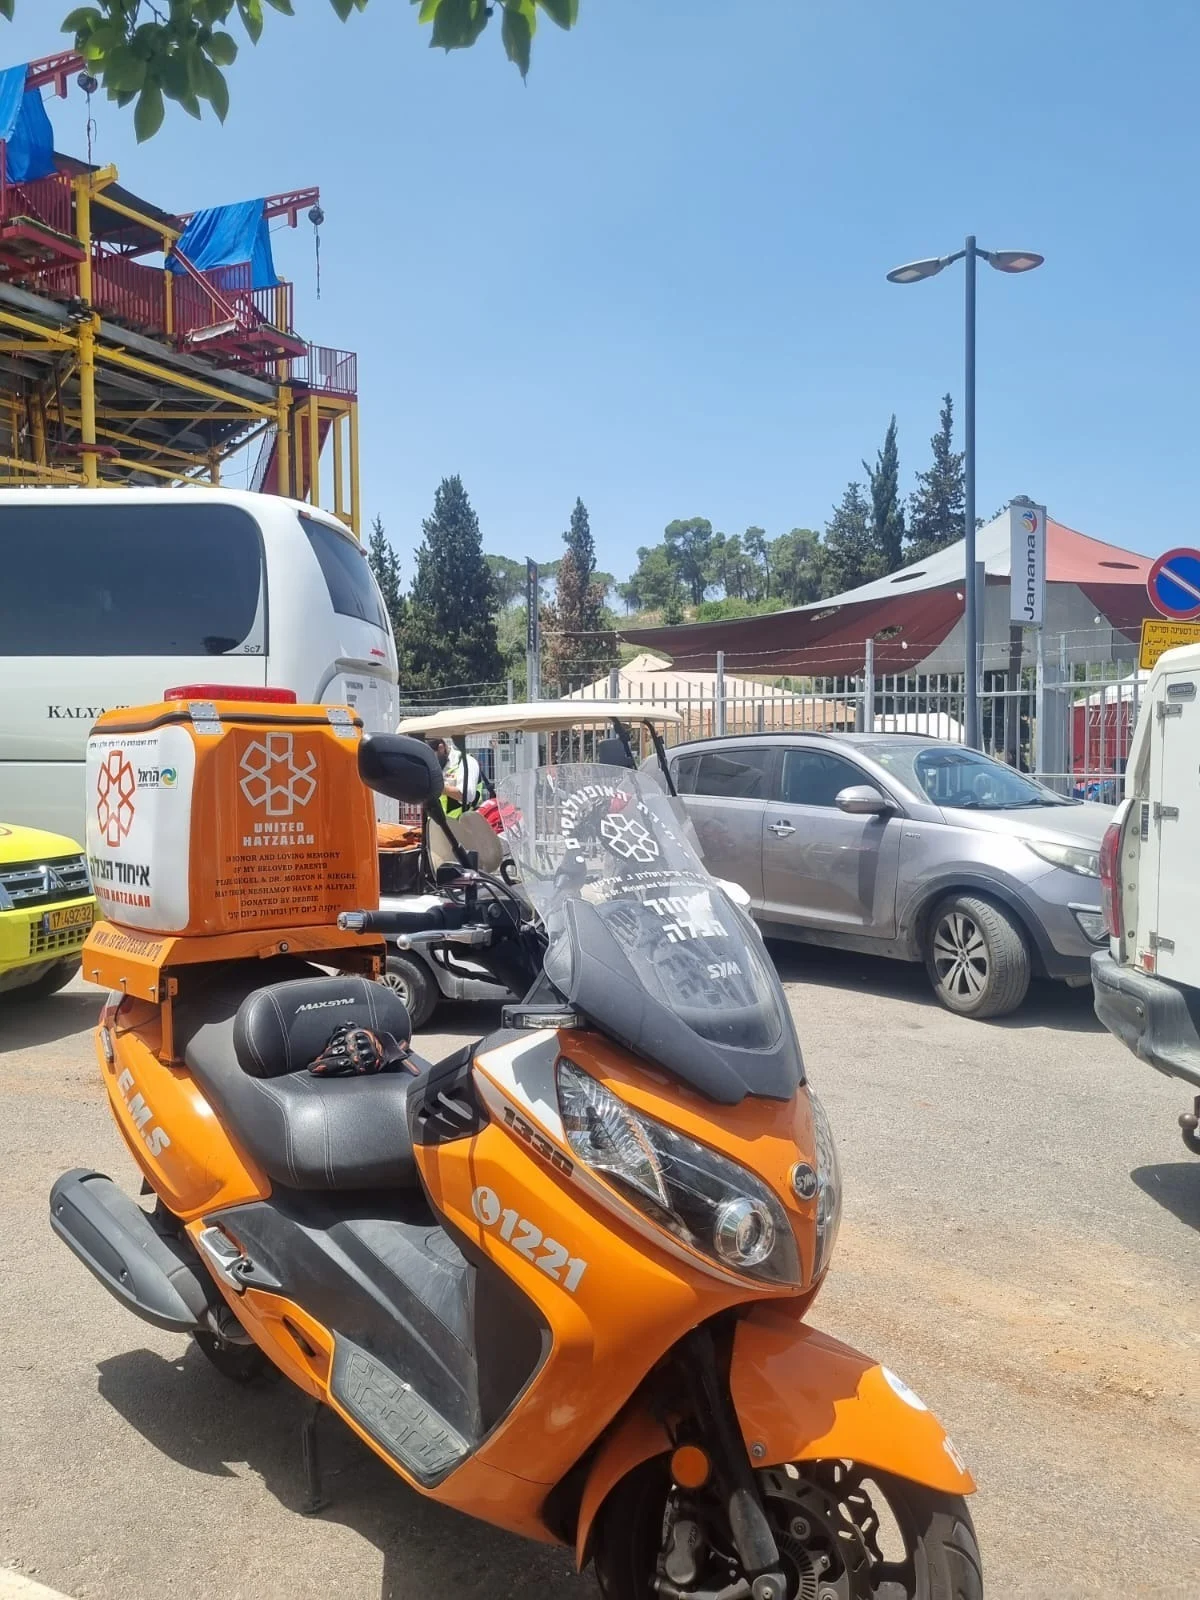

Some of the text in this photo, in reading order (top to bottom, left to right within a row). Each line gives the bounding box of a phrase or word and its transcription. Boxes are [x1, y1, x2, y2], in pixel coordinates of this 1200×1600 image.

[1023, 533, 1036, 621] Janana
[137, 767, 159, 783] הראל
[254, 822, 305, 833] UNITED
[243, 834, 315, 846] HATZALAH
[277, 852, 305, 861] LOVING
[306, 851, 341, 859] MEMORY
[114, 860, 150, 887] איחוד
[292, 885, 313, 893] HAVE
[111, 889, 151, 908] HATZALAH
[240, 897, 279, 906] DONATED
[280, 896, 290, 904] BY
[707, 961, 742, 979] SYM
[294, 998, 355, 1014] MAXSYM
[503, 1106, 574, 1178] 1330
[499, 1208, 588, 1293] 1221
